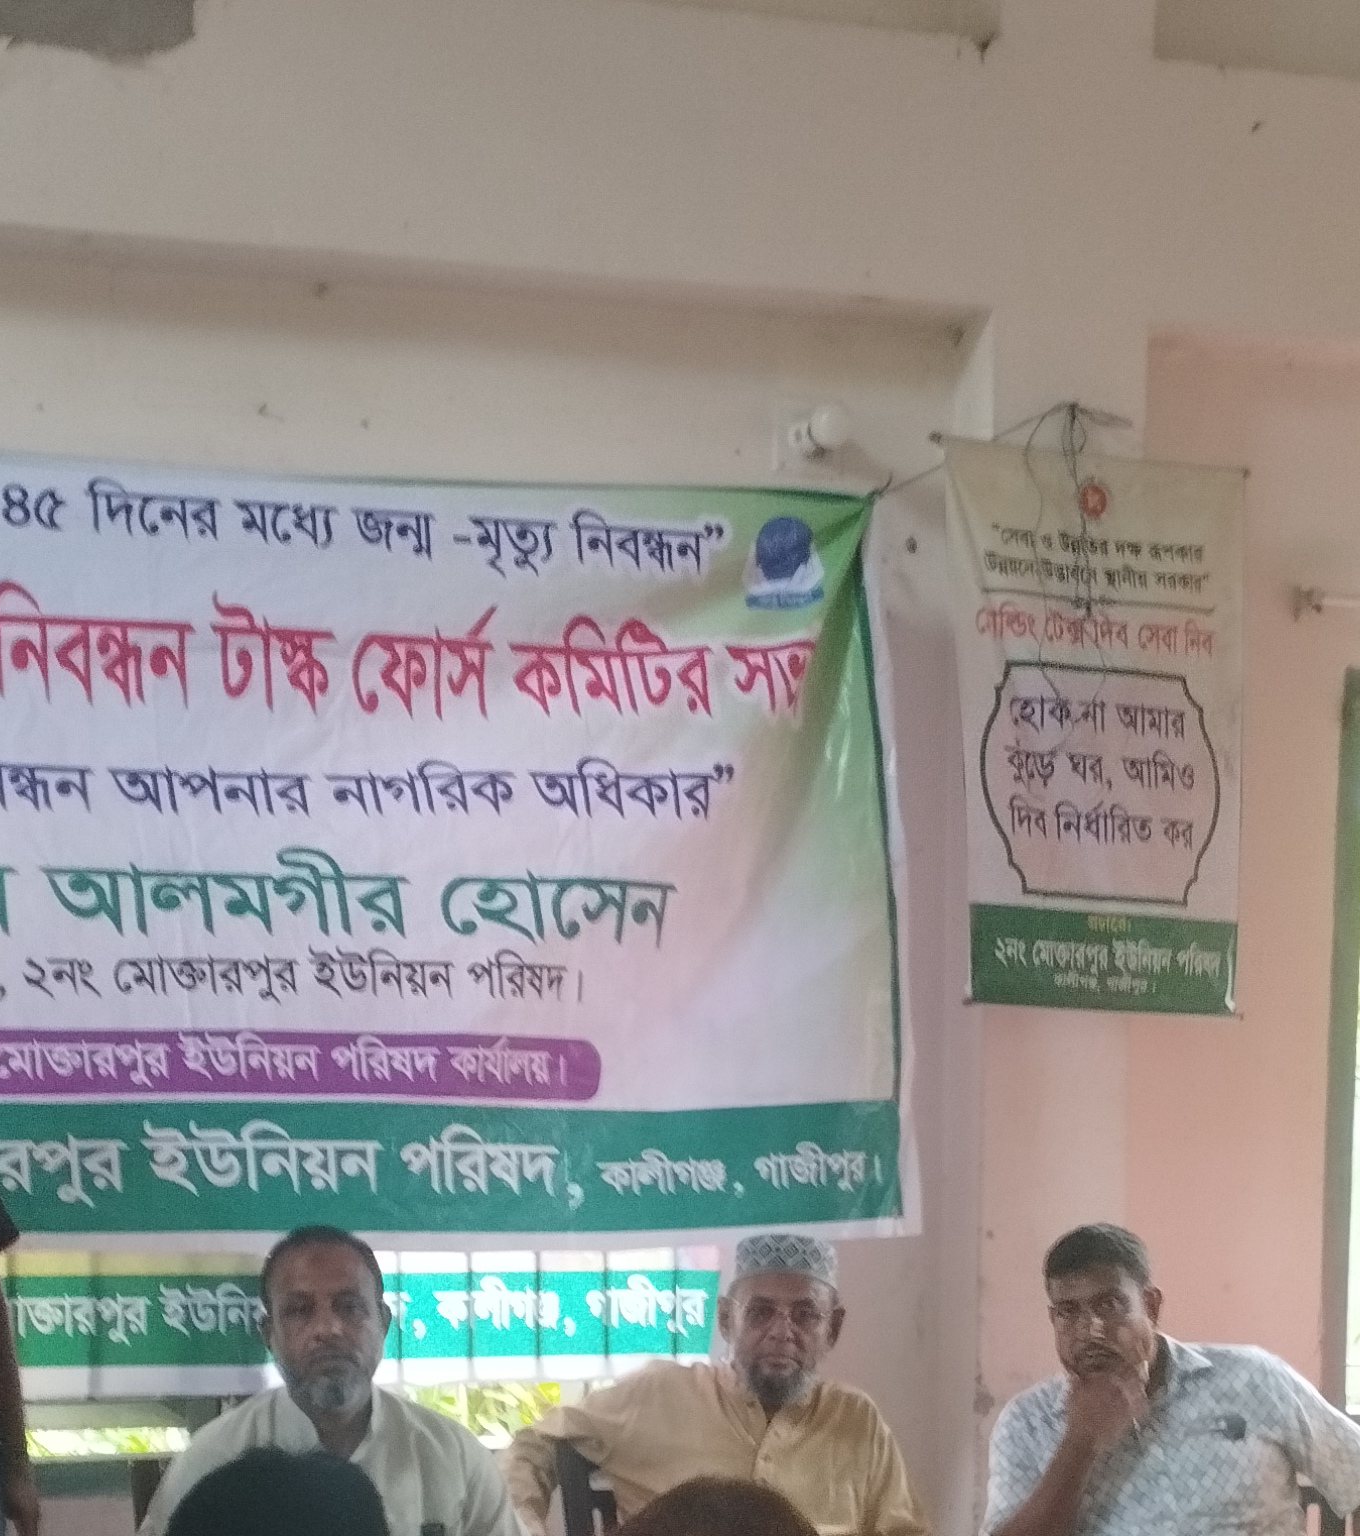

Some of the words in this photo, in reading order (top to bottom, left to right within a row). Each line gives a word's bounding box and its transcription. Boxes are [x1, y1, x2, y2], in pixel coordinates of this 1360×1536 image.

[2, 488, 67, 531] ৪৫
[88, 479, 220, 541] দিনের
[237, 500, 341, 549] মধ্যে
[354, 510, 435, 562] জন্ম
[351, 603, 498, 721] ফোর্স
[507, 614, 714, 719] কমিটির
[1115, 703, 1185, 740] আমার
[112, 762, 311, 816] আপনার
[326, 760, 515, 818] নাগরিক
[530, 757, 735, 820] অধিকার”
[1122, 750, 1194, 790] আমিও
[1008, 795, 1047, 841] দিব
[1055, 800, 1153, 844] নির্ধারিত
[1160, 816, 1193, 849] কর
[38, 844, 411, 940] আলমগীর
[439, 870, 679, 951] হোসেন
[22, 955, 100, 999] ২নং
[112, 953, 300, 1004] মোক্তারপুর
[307, 945, 455, 1000] ইউনিয়ন
[995, 937, 1027, 968] ২নং
[177, 1030, 321, 1083] ইউনিয়ন
[330, 1034, 440, 1083] পরিষদ
[139, 1119, 385, 1197] ইউনিয়ন
[14, 1292, 152, 1347] াক্তারপুর
[158, 1282, 268, 1337] ইউনি
